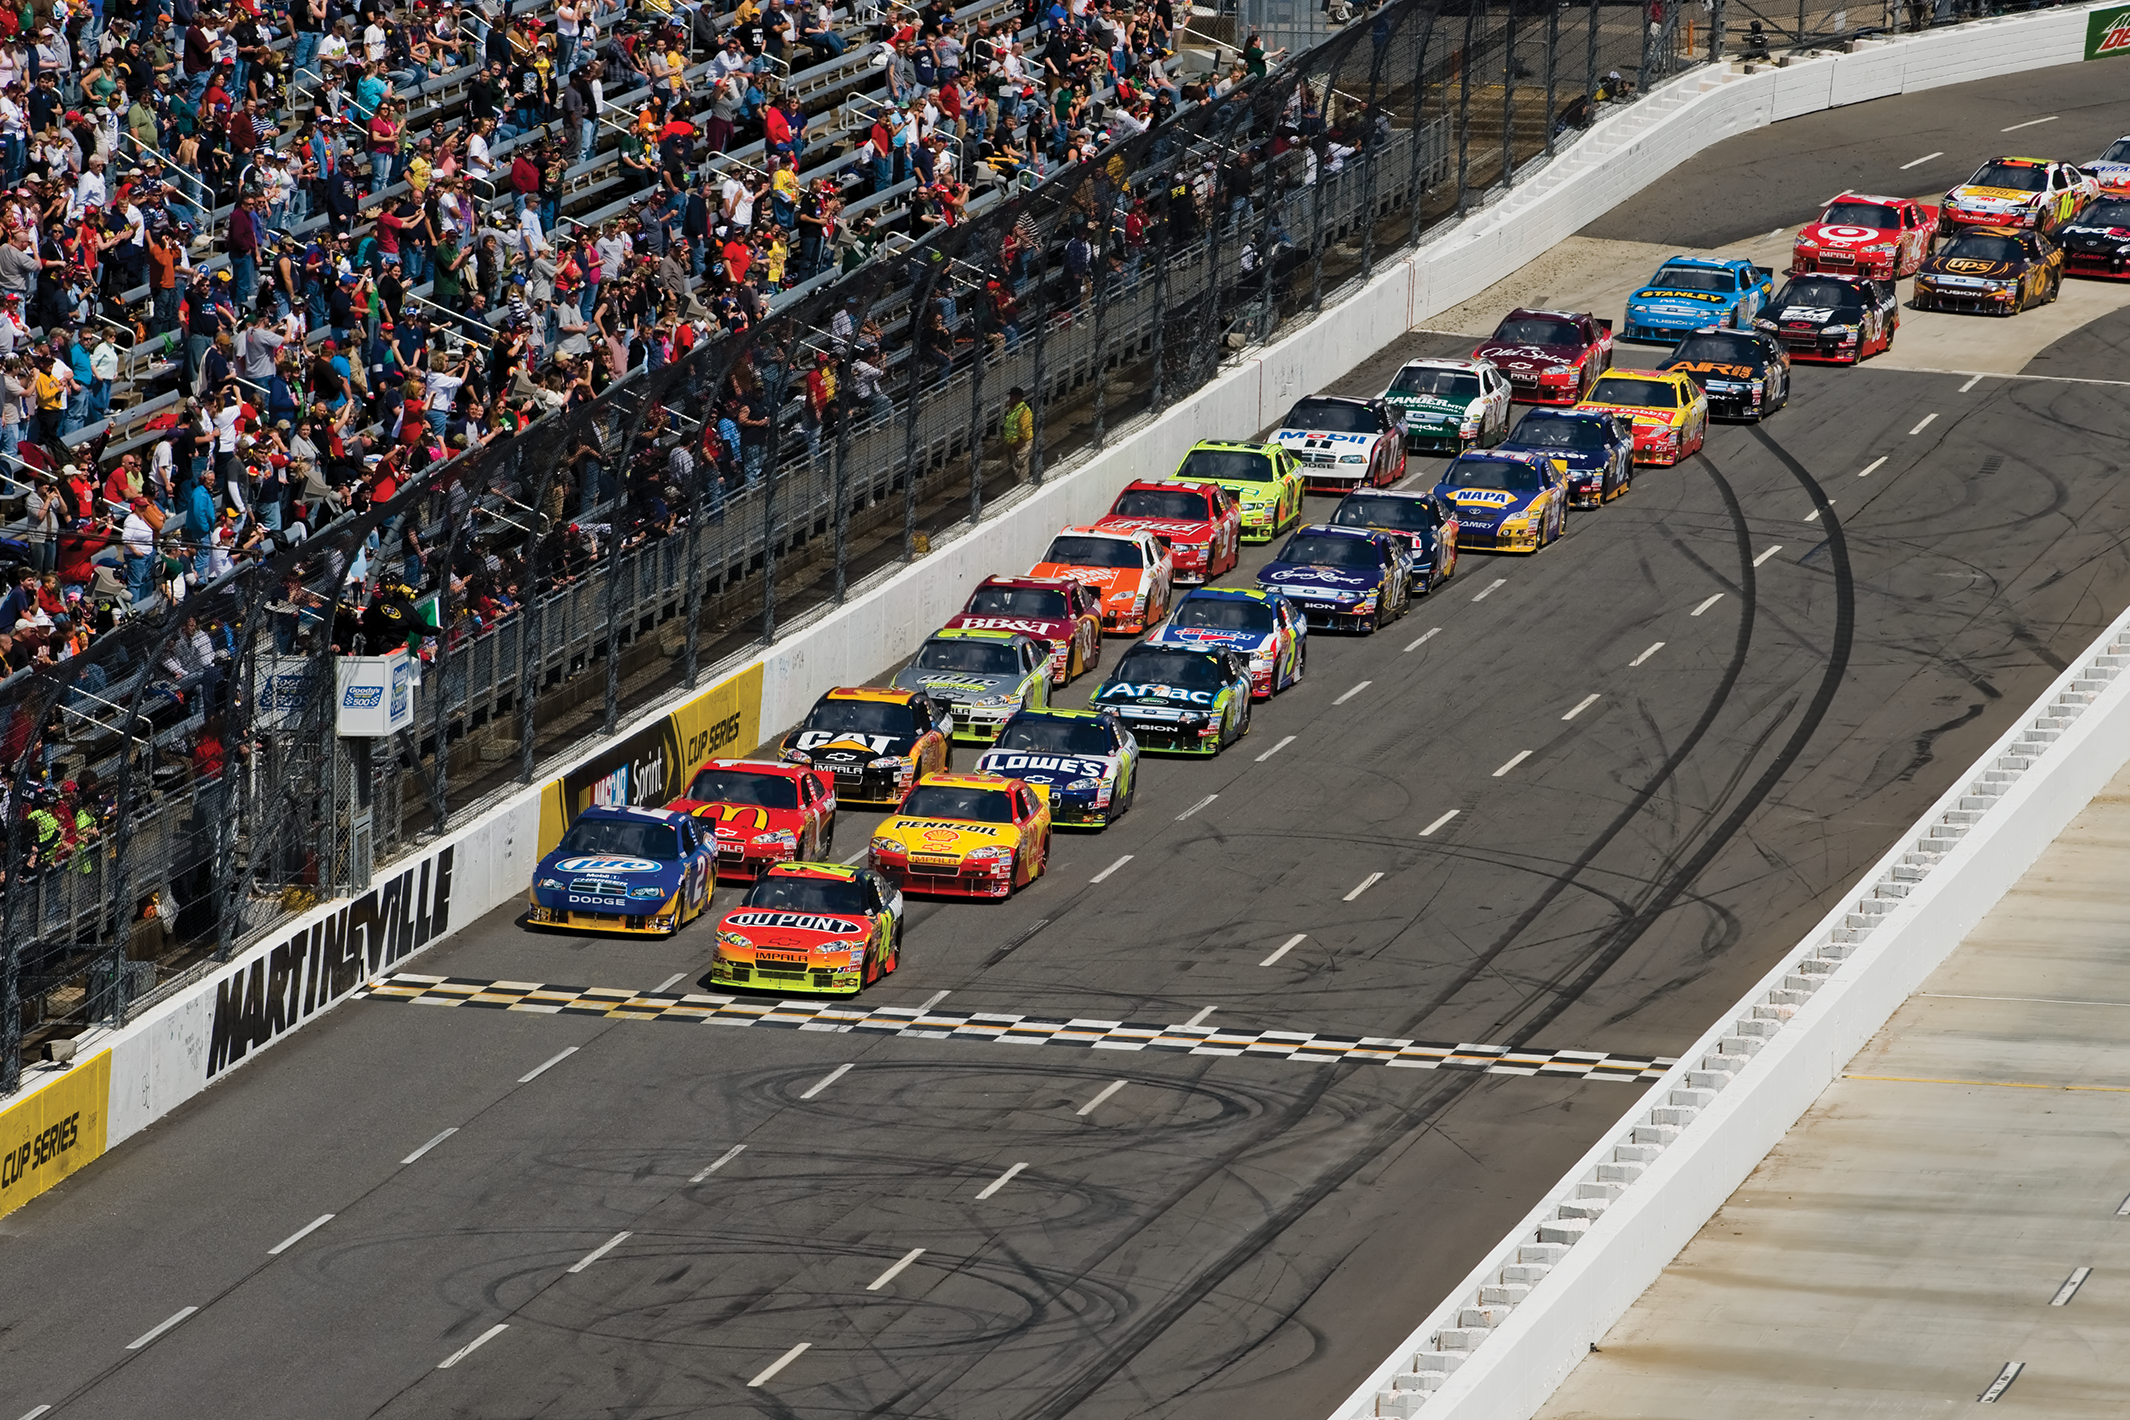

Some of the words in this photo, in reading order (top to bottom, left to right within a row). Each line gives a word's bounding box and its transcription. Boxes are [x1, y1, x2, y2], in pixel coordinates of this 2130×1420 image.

[2058, 190, 2075, 224] 16
[1958, 214, 2001, 223] FUSION
[2062, 225, 2130, 237] FedE
[1819, 250, 1856, 259] IMPALA
[2072, 252, 2107, 260] CAMRY
[1641, 290, 1722, 302] STANLEY
[1935, 288, 1982, 297] FUSION
[1647, 317, 1695, 326] FUSION
[1520, 350, 1572, 365] Spice
[1510, 373, 1538, 381] PALA
[1278, 431, 1367, 445] Mobil
[1457, 491, 1506, 503] NAPA
[1458, 520, 1495, 529] CAMRY
[1220, 520, 1231, 560] 9
[960, 617, 1060, 636] BB&T
[349, 687, 380, 695] Goody's
[353, 698, 370, 706] 500
[688, 729, 708, 766] CUP
[708, 712, 741, 755] SERIES
[796, 731, 901, 756] CAT
[814, 764, 863, 775] IMPALA
[986, 755, 1102, 777] LOWE'S
[633, 746, 663, 807] Sprint
[895, 820, 1000, 837] PENNZOIL
[911, 856, 958, 865] IMPALA
[573, 878, 628, 886] CHARGER
[691, 854, 706, 904] 2
[568, 895, 626, 907] DODGE
[206, 844, 455, 1080] MARTINSVILLE
[755, 952, 808, 962] IMPALA
[2, 1141, 31, 1189] CUP
[32, 1110, 80, 1171] SERIES
